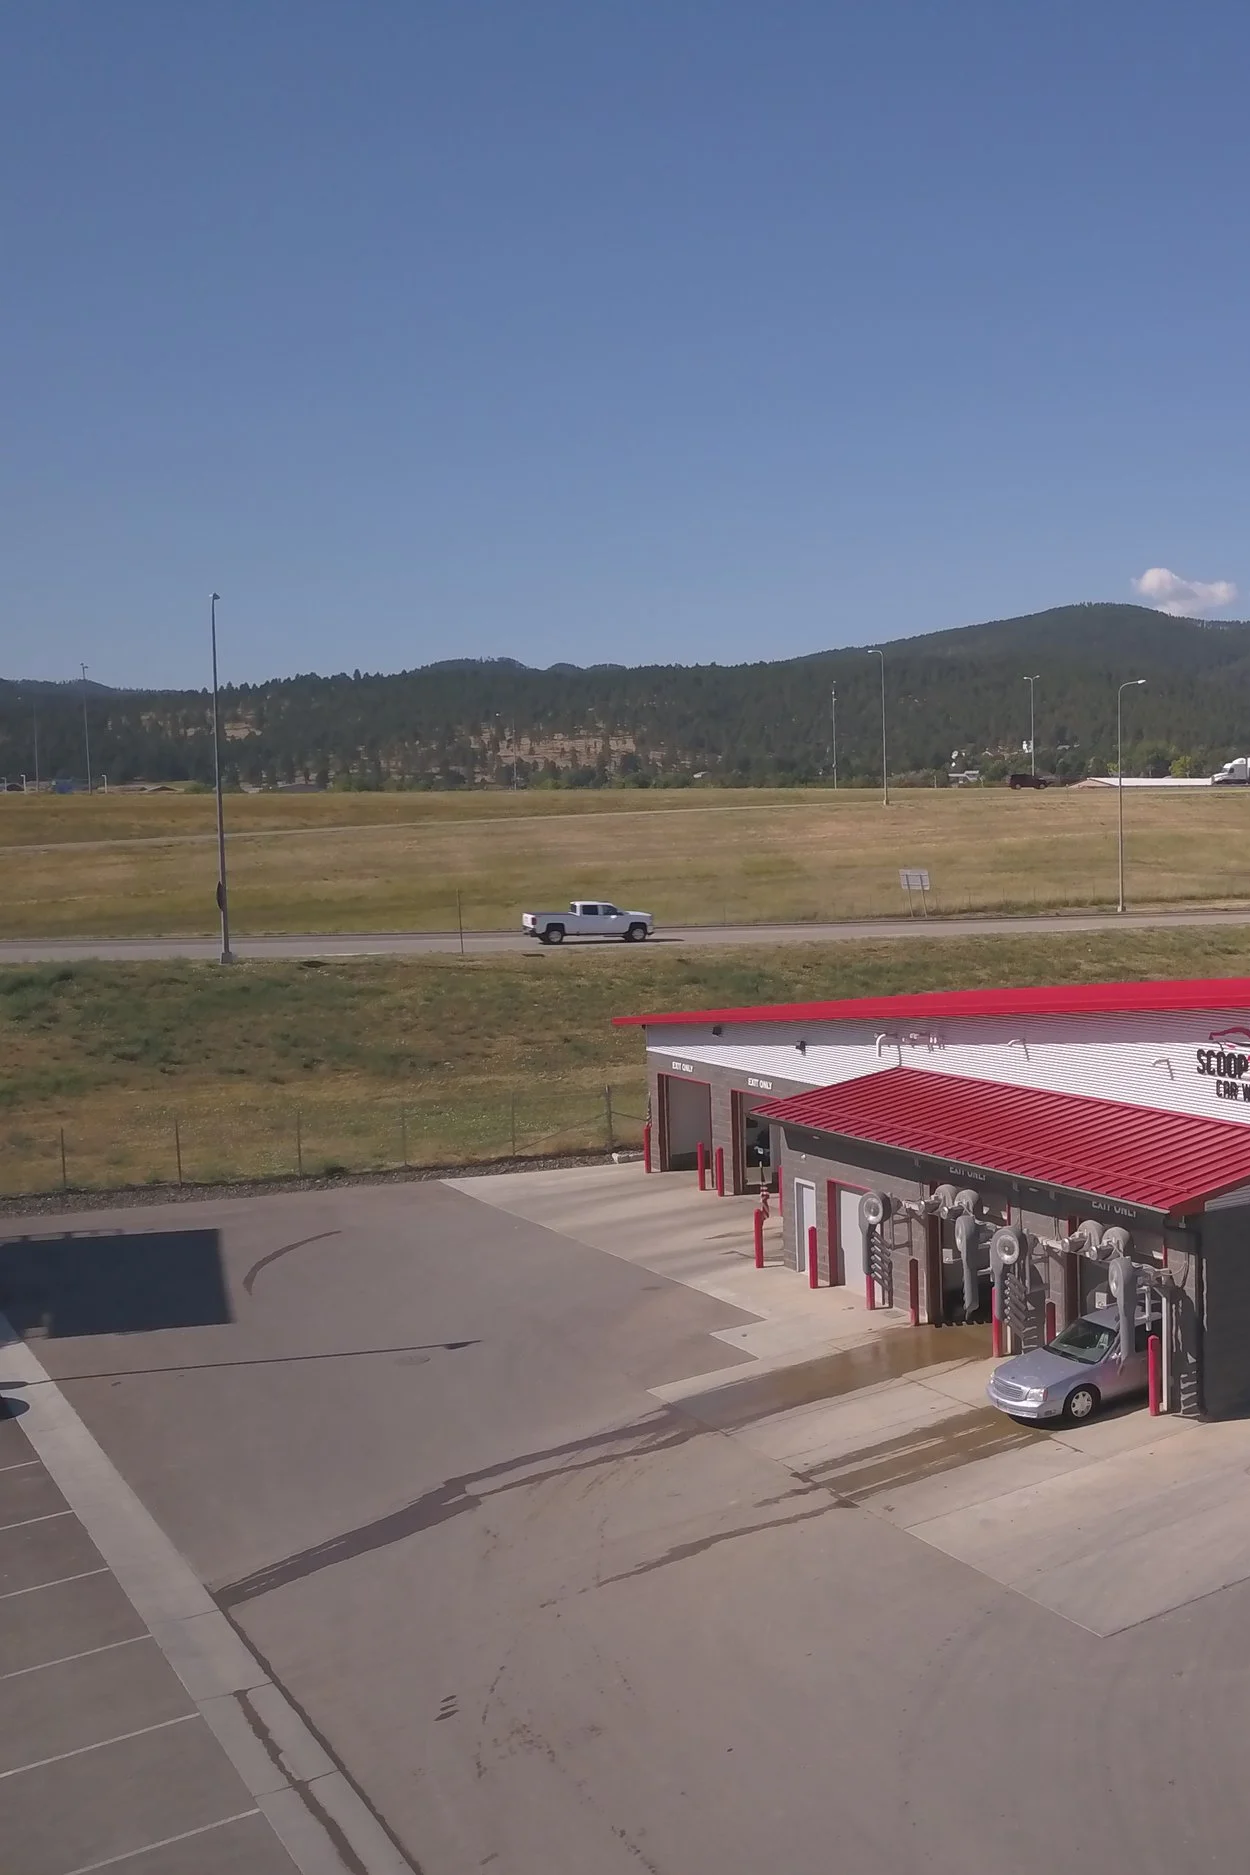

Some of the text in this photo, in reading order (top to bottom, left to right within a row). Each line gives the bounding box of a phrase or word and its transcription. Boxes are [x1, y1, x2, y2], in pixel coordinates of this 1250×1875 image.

[672, 1061, 694, 1073] EXIT ONLY
[748, 1078, 773, 1090] EXIT ONLY
[1216, 1080, 1239, 1100] CAR
